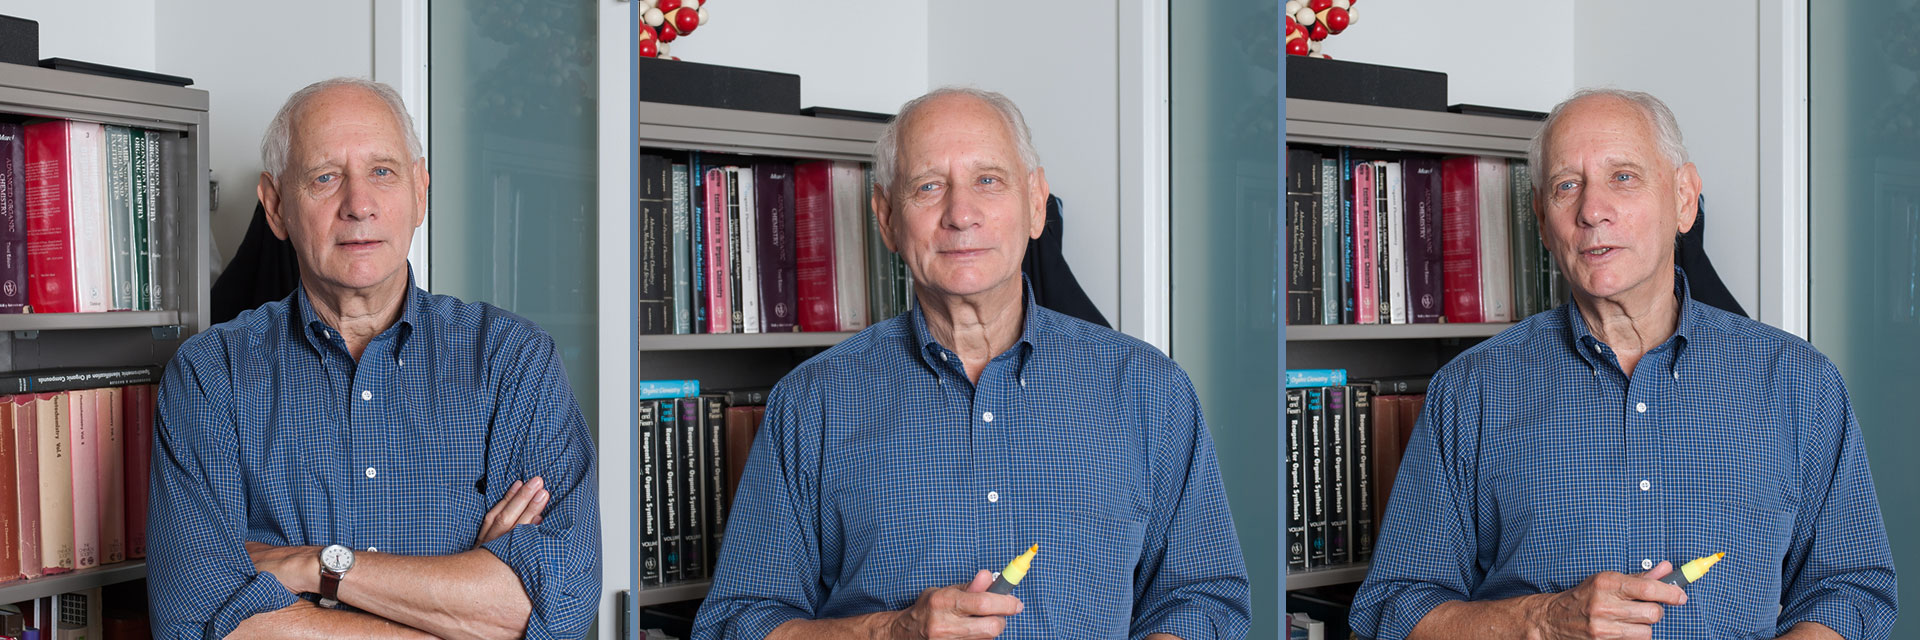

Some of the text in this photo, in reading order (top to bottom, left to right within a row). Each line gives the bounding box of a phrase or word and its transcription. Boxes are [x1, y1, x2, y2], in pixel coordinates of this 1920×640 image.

[118, 134, 122, 142] IN
[6, 158, 14, 197] ADVANCED
[680, 171, 685, 180] IN
[1329, 166, 1334, 174] IN
[142, 185, 147, 194] IN
[156, 188, 160, 197] IN
[1364, 262, 1372, 289] Chemistry
[38, 376, 66, 384] Compounds
[92, 372, 120, 380] Identification
[122, 369, 150, 378] Spectrometric
[687, 426, 695, 457] Reagents
[1291, 420, 1299, 449] Reagents
[1312, 416, 1320, 445] Reagents
[1333, 414, 1341, 444] Reagents
[643, 432, 651, 462] Reagents
[665, 428, 673, 458] Reagents
[1291, 463, 1300, 488] Organic
[1313, 458, 1321, 484] Organic
[1334, 456, 1343, 481] Organic
[1360, 455, 1368, 479] Organic
[644, 476, 652, 502] Organic
[666, 471, 674, 497] Organic
[688, 470, 696, 495] Organic
[714, 468, 722, 494] Organic
[1293, 489, 1301, 520] Synthesis
[1314, 484, 1322, 515] Synthesis
[1336, 482, 1344, 513] Synthesis
[1361, 480, 1369, 510] Synthesis
[645, 503, 654, 535] Synthesis
[667, 498, 676, 530] Synthesis
[689, 496, 697, 527] Synthesis
[714, 494, 723, 524] Synthesis
